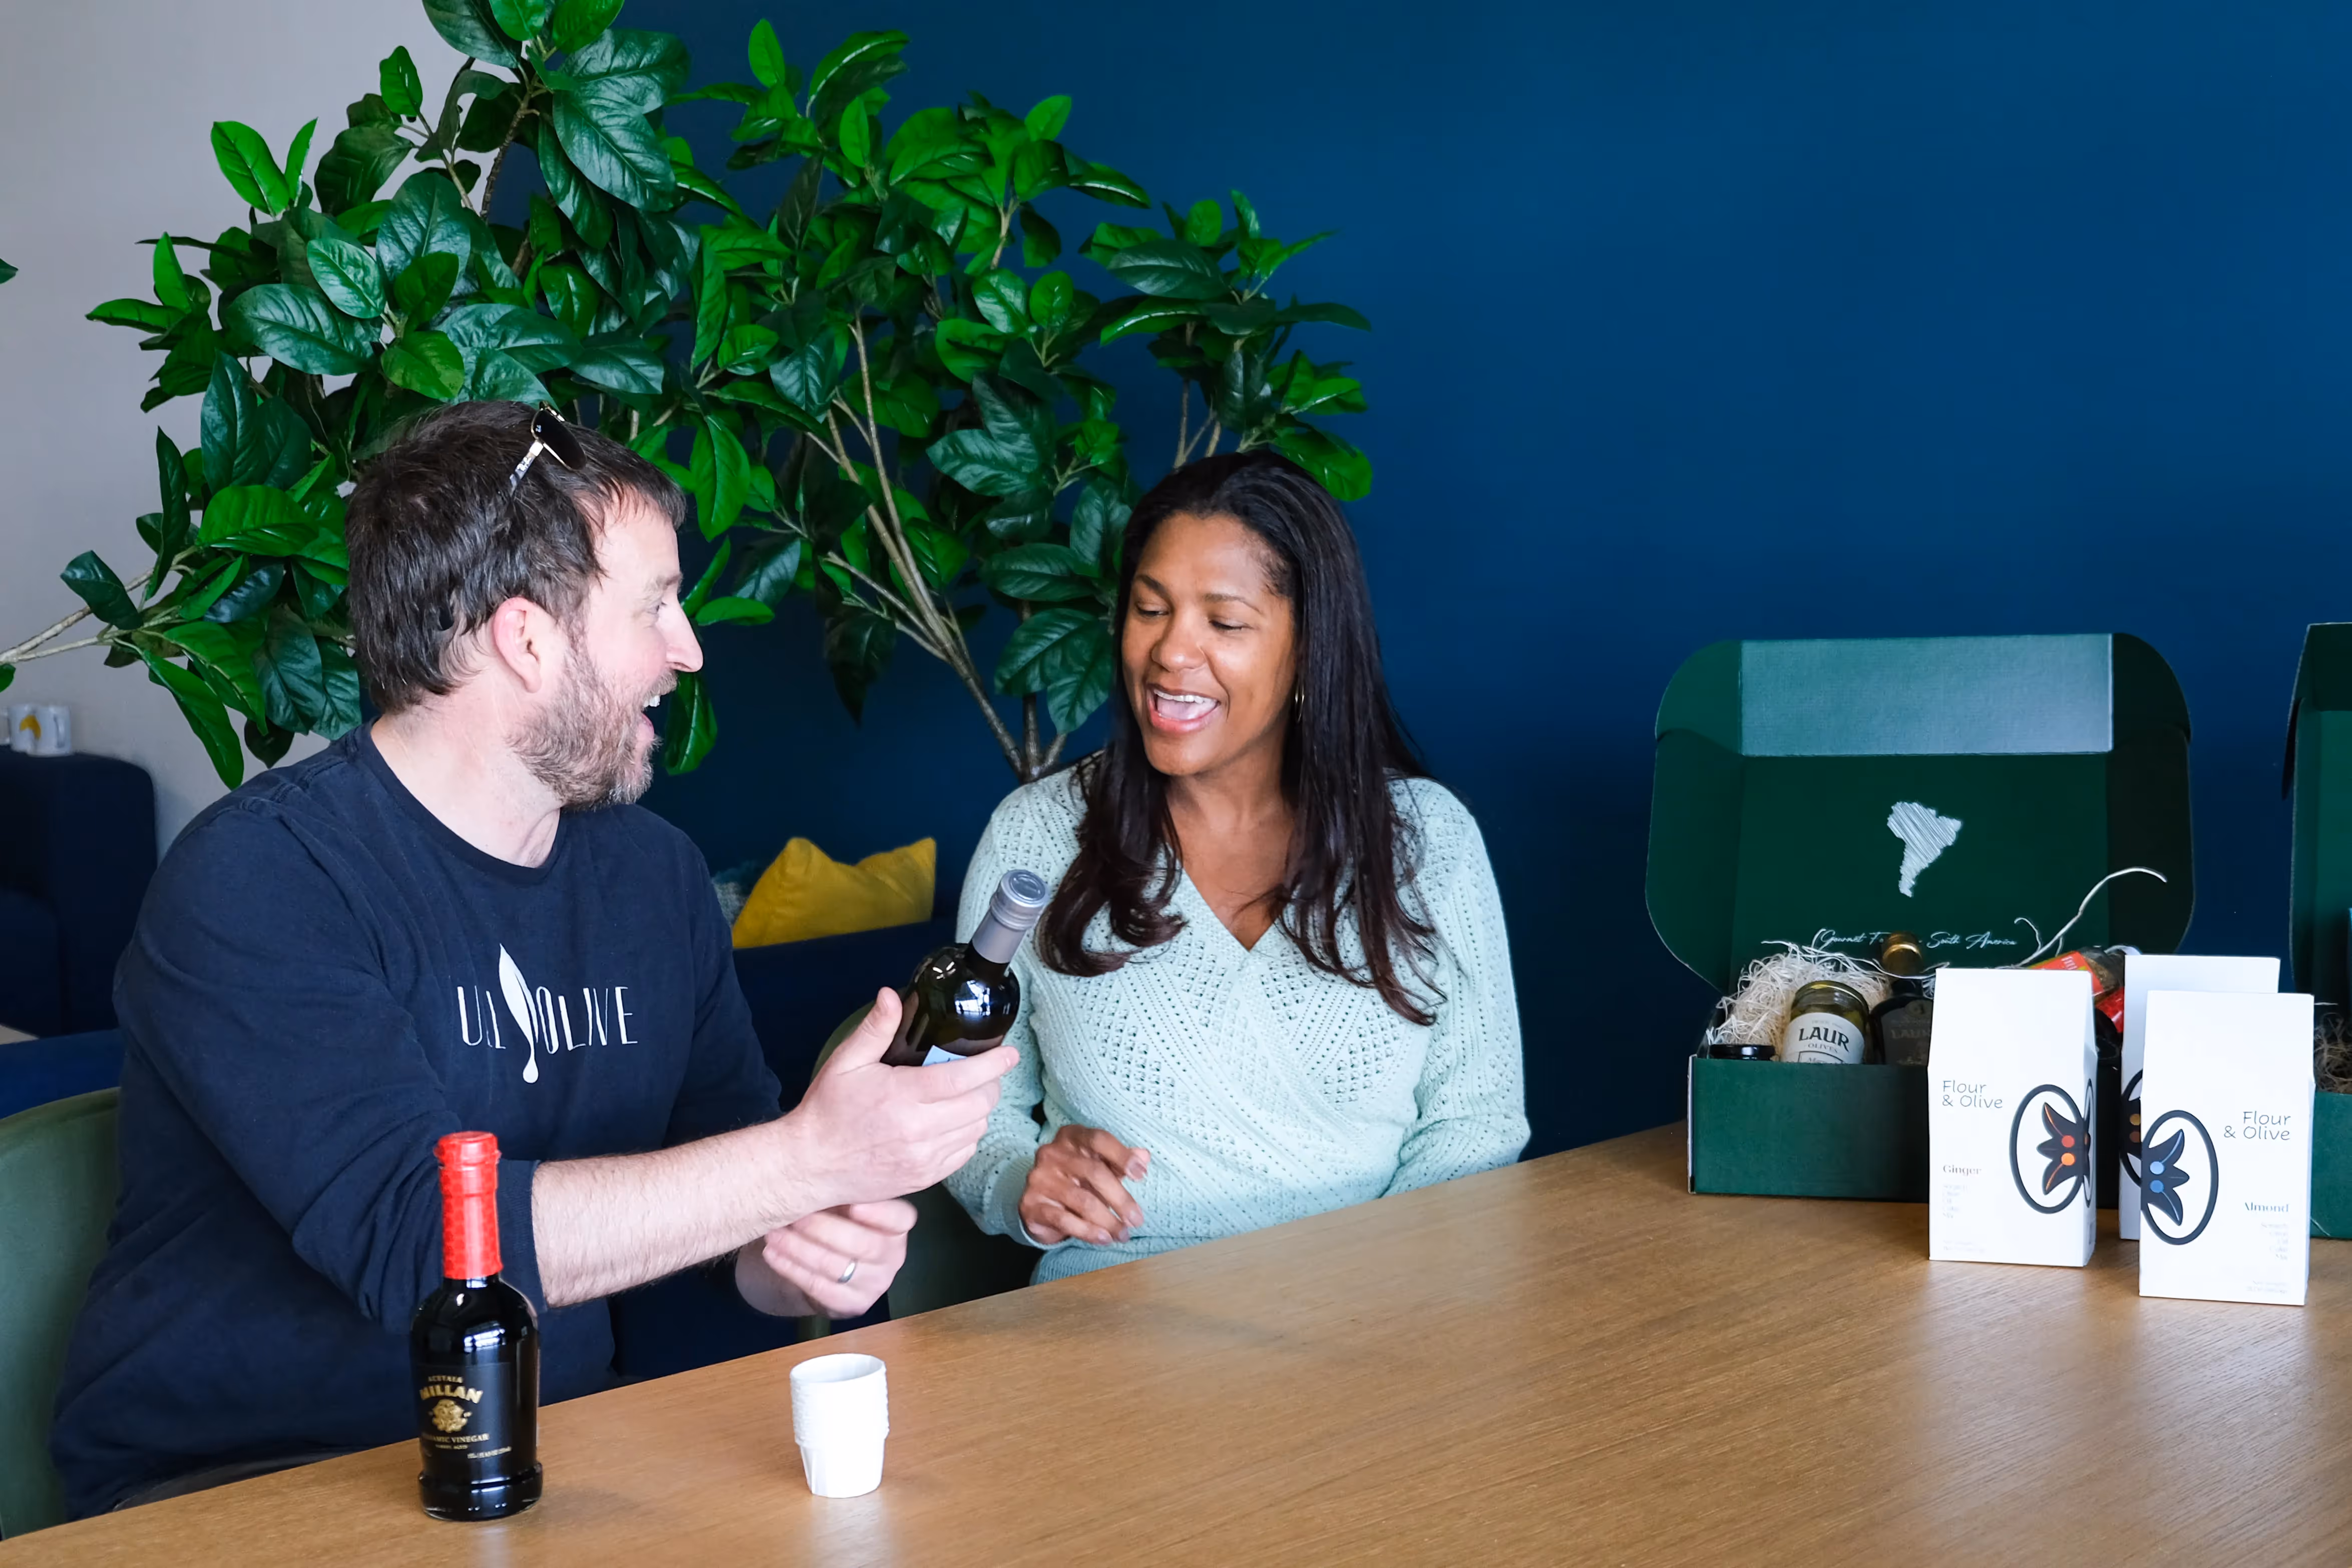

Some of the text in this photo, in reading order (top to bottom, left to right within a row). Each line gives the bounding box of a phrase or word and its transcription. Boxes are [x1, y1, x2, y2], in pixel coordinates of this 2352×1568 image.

[1926, 932, 1961, 949] South
[1966, 931, 2017, 950] America
[1799, 1027, 1849, 1053] LAUR
[1942, 1079, 1987, 1093] Flour
[1942, 1094, 2003, 1108] & Olive
[2243, 1110, 2291, 1125] Flour
[2223, 1125, 2290, 1140] & Olive
[1942, 1164, 1982, 1177] Ginger
[2244, 1202, 2289, 1213] Almond
[452, 1433, 490, 1443] VINEGAR
